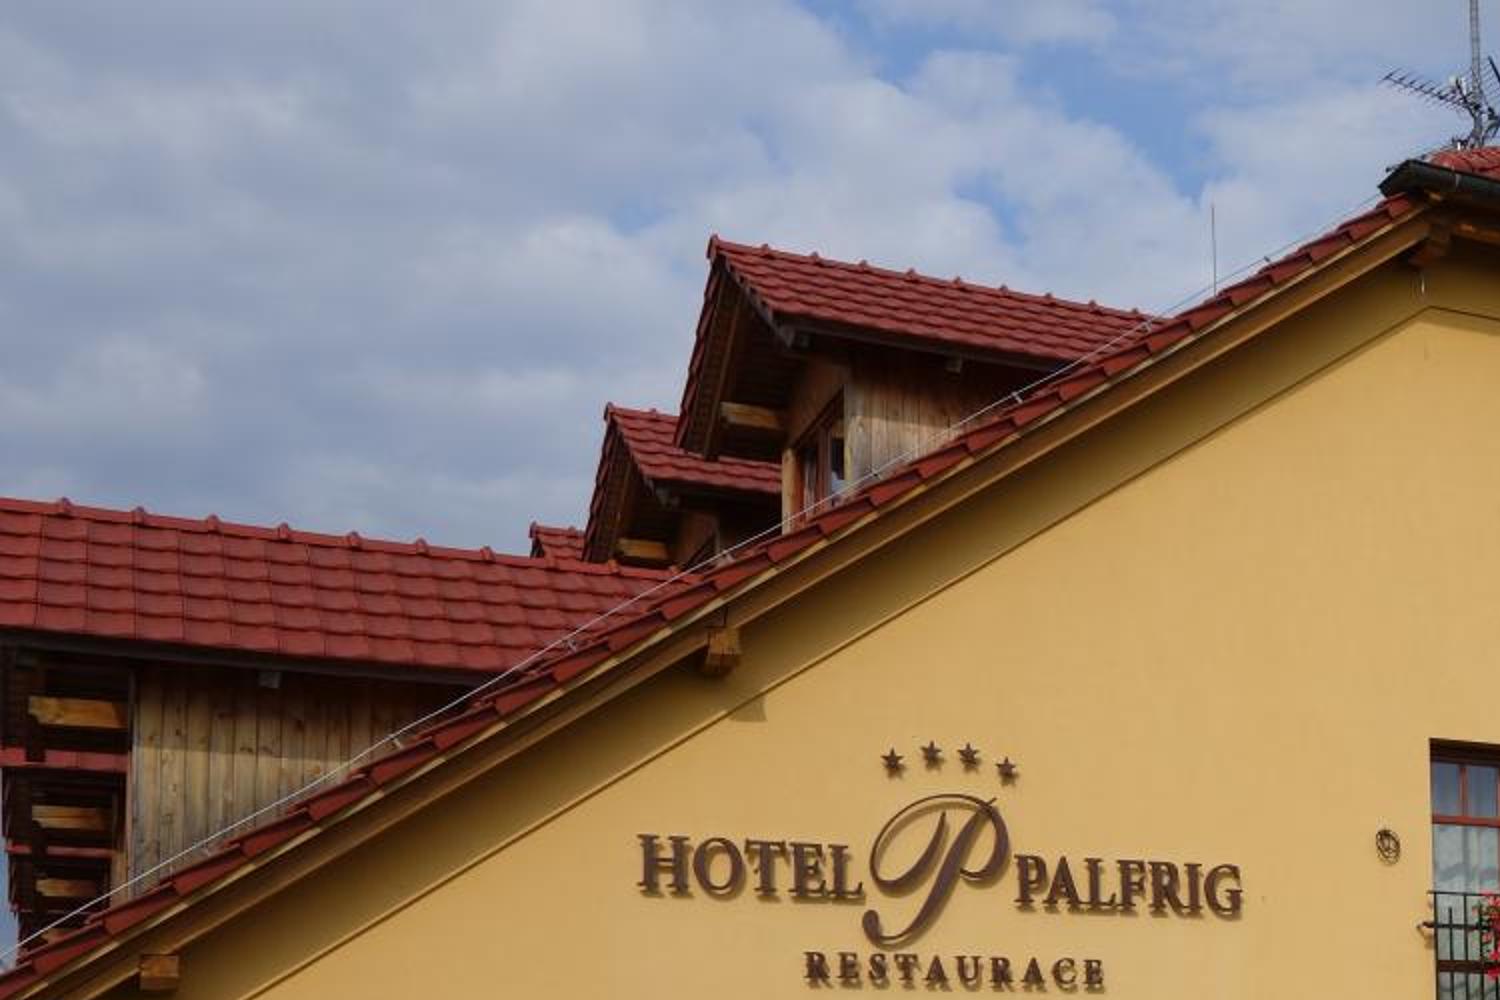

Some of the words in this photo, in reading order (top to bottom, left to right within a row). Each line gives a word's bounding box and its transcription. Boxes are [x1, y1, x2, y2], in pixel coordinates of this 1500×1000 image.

[636, 833, 864, 899] HOTEL
[1013, 854, 1243, 917] PALFRIG
[803, 951, 1105, 989] RESTAURACE
